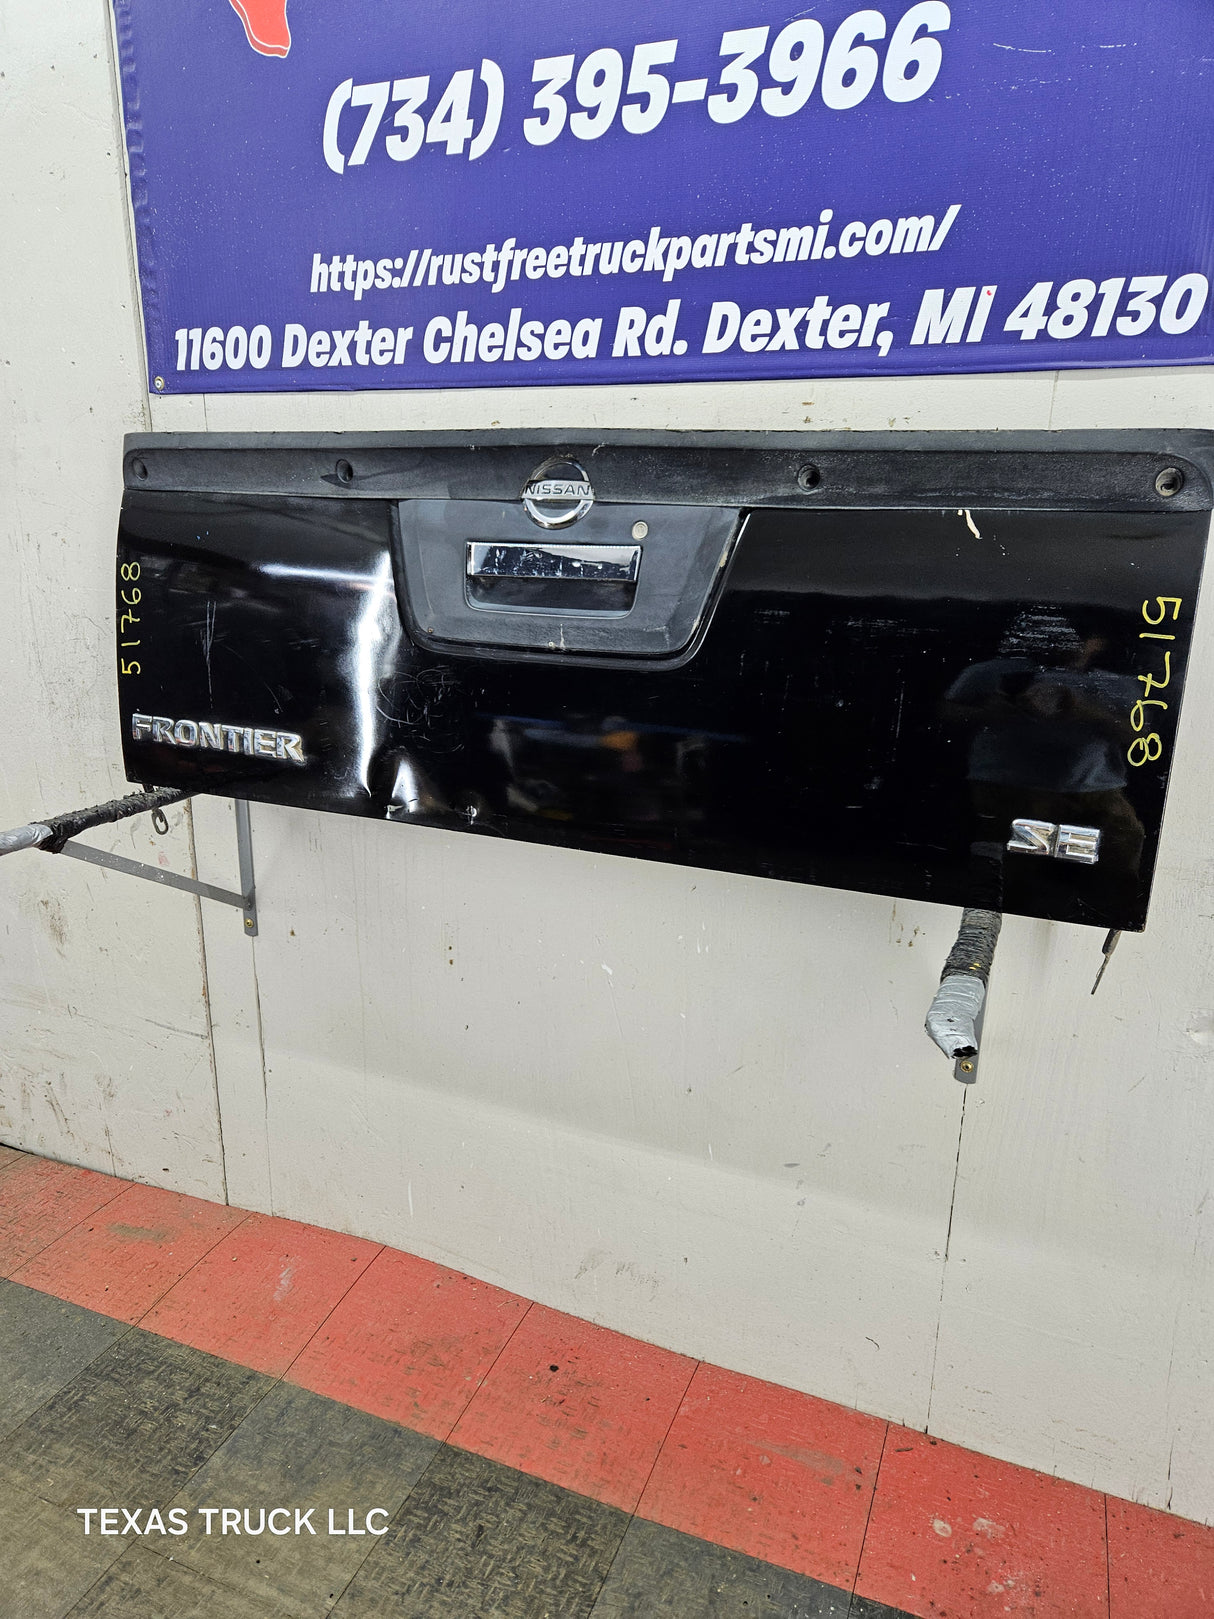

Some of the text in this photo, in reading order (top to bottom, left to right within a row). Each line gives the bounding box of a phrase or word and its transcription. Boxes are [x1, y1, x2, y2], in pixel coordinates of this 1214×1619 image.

[322, 0, 952, 175] (734) 395-3966
[309, 203, 963, 301] https://rustfreetruckpartsmi.com/
[174, 272, 1209, 371] 11600 Dexter Chelsea Rd. Dexter, MI 48130
[524, 483, 591, 496] NISSAN
[119, 560, 142, 676] 51768
[1127, 596, 1183, 767] 51768
[131, 713, 305, 764] FRONTIER
[1006, 818, 1101, 865] SE
